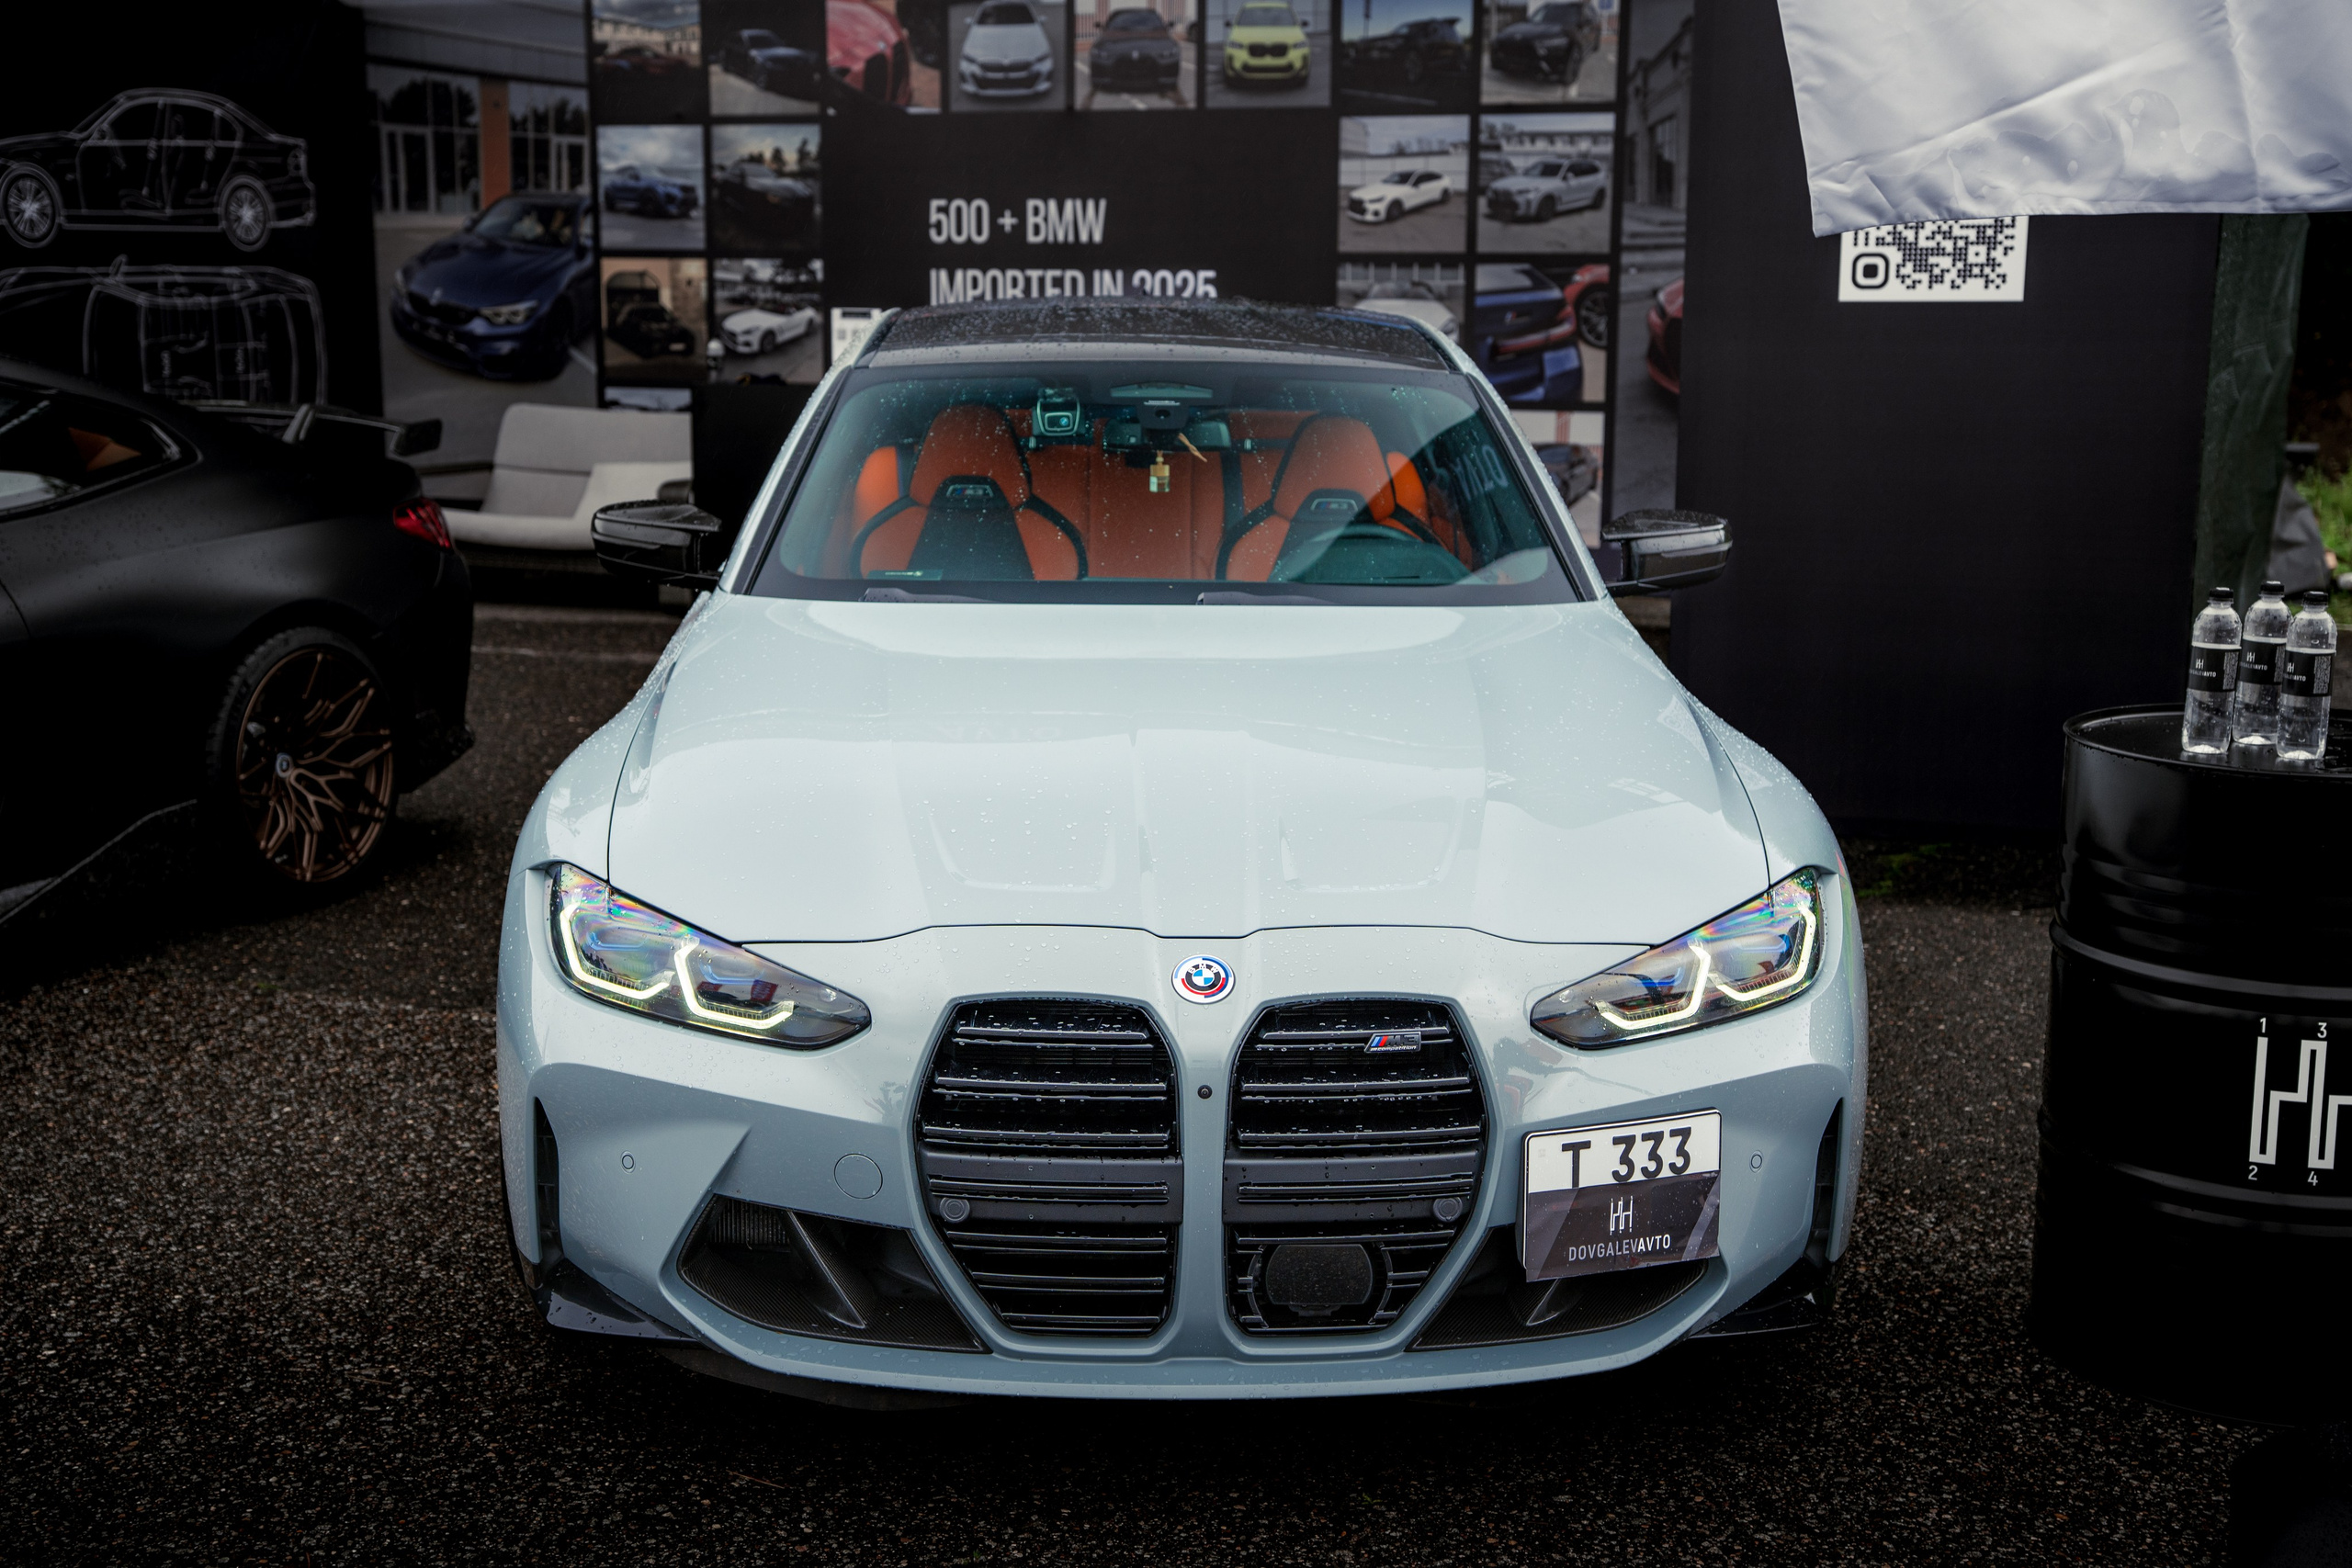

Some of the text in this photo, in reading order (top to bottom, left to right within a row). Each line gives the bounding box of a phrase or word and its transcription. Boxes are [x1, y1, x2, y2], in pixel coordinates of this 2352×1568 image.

[928, 197, 1107, 244] 500 + BMW
[929, 267, 1086, 307] IMPORTED
[1092, 268, 1125, 298] IN
[1187, 963, 1220, 975] BMW
[2259, 1017, 2328, 1039] 1 3
[1561, 1126, 1692, 1189] T 333
[2247, 1164, 2319, 1187] 2 4
[1567, 1234, 1671, 1262] DOVGALEVAVTO
